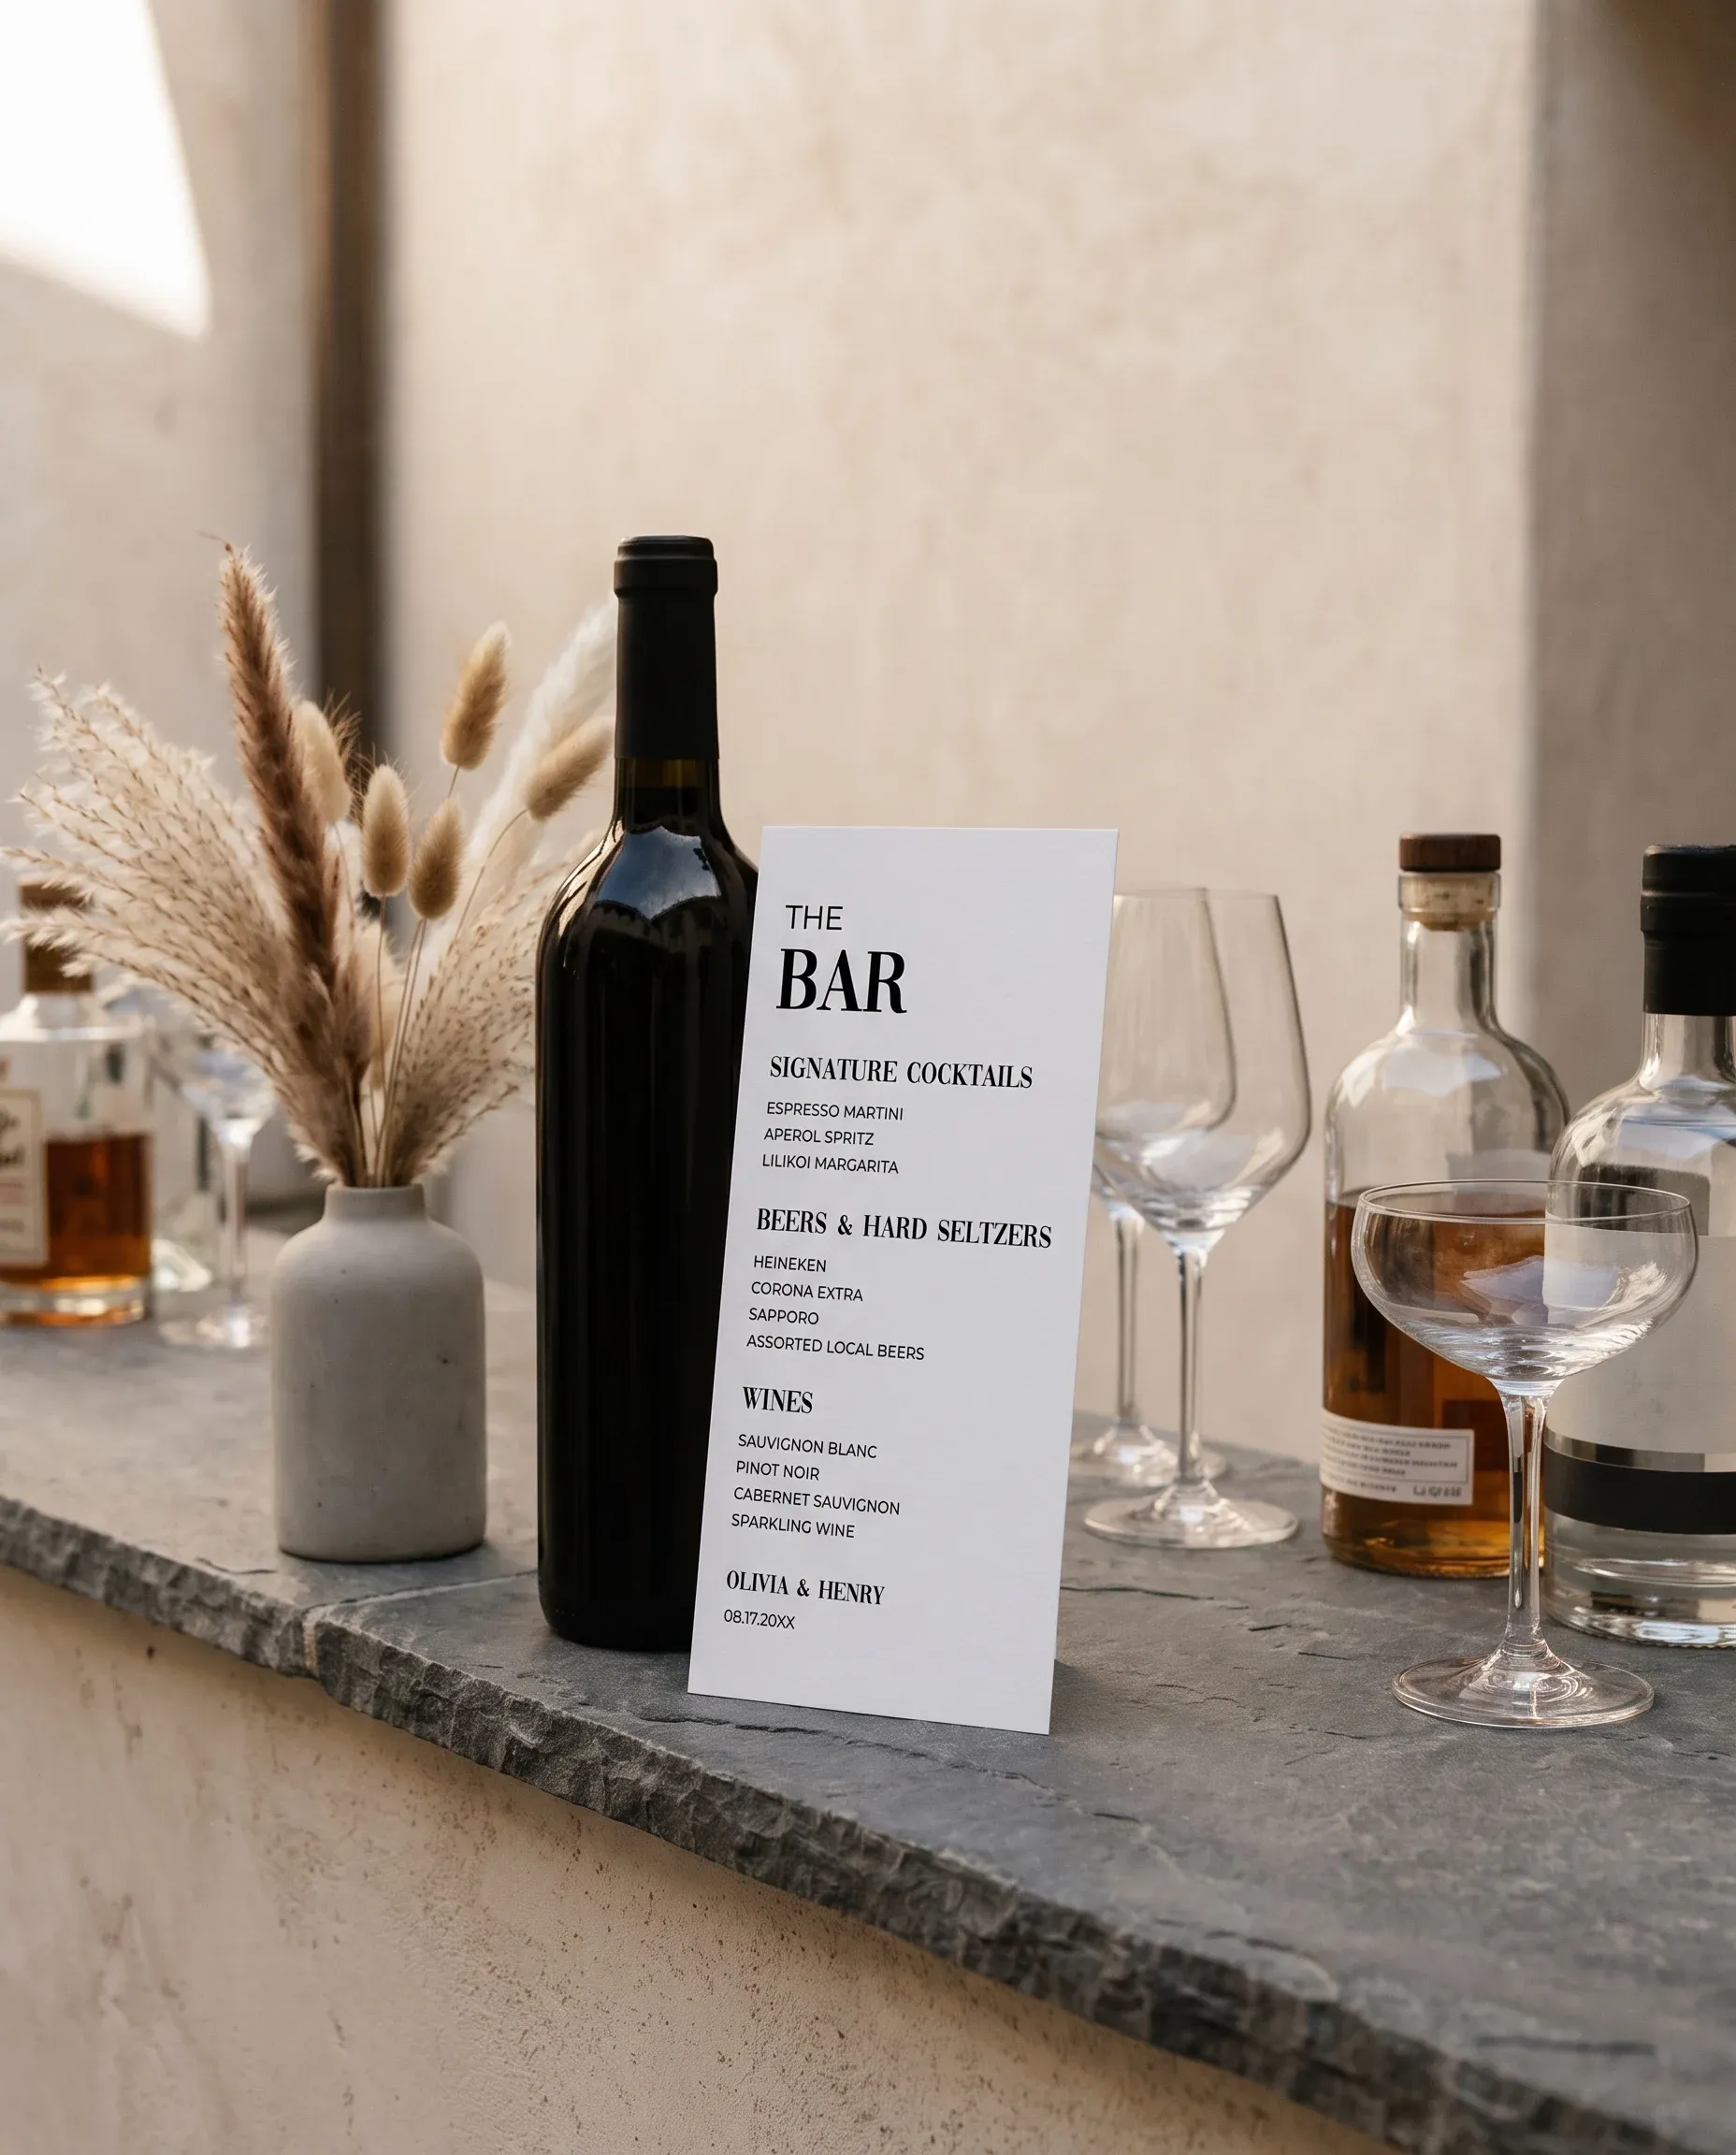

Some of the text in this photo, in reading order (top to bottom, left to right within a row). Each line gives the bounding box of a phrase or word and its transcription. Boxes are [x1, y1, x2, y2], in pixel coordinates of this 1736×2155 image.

[786, 905, 843, 930] THE
[776, 948, 907, 1014] BAR
[771, 1056, 1032, 1088] SIGNATURE COCKTAILS
[767, 1102, 903, 1121] ESPRESSO MARTINI
[764, 1128, 874, 1145] APEROL SPRITZ
[763, 1154, 898, 1174] LILIKOI MARGARITA
[757, 1208, 1051, 1248] BEERS & HARD SELTZERS
[754, 1255, 826, 1272] HEINEKEN
[751, 1281, 862, 1301] CORONA EXTRA
[749, 1308, 818, 1324] SAPPORO
[746, 1335, 924, 1360] ASSORTED LOCAL BEERS
[743, 1386, 813, 1413] WINES
[738, 1434, 876, 1458] SAUVIGNON BLANC
[737, 1460, 819, 1481] PINOT NOIR
[734, 1487, 900, 1514] CABERNET SAUVIGNON
[731, 1513, 855, 1538] SPARKLING WINE
[727, 1570, 885, 1605] OLIVIA & HENRY
[724, 1610, 795, 1629] 08.17.20XX
